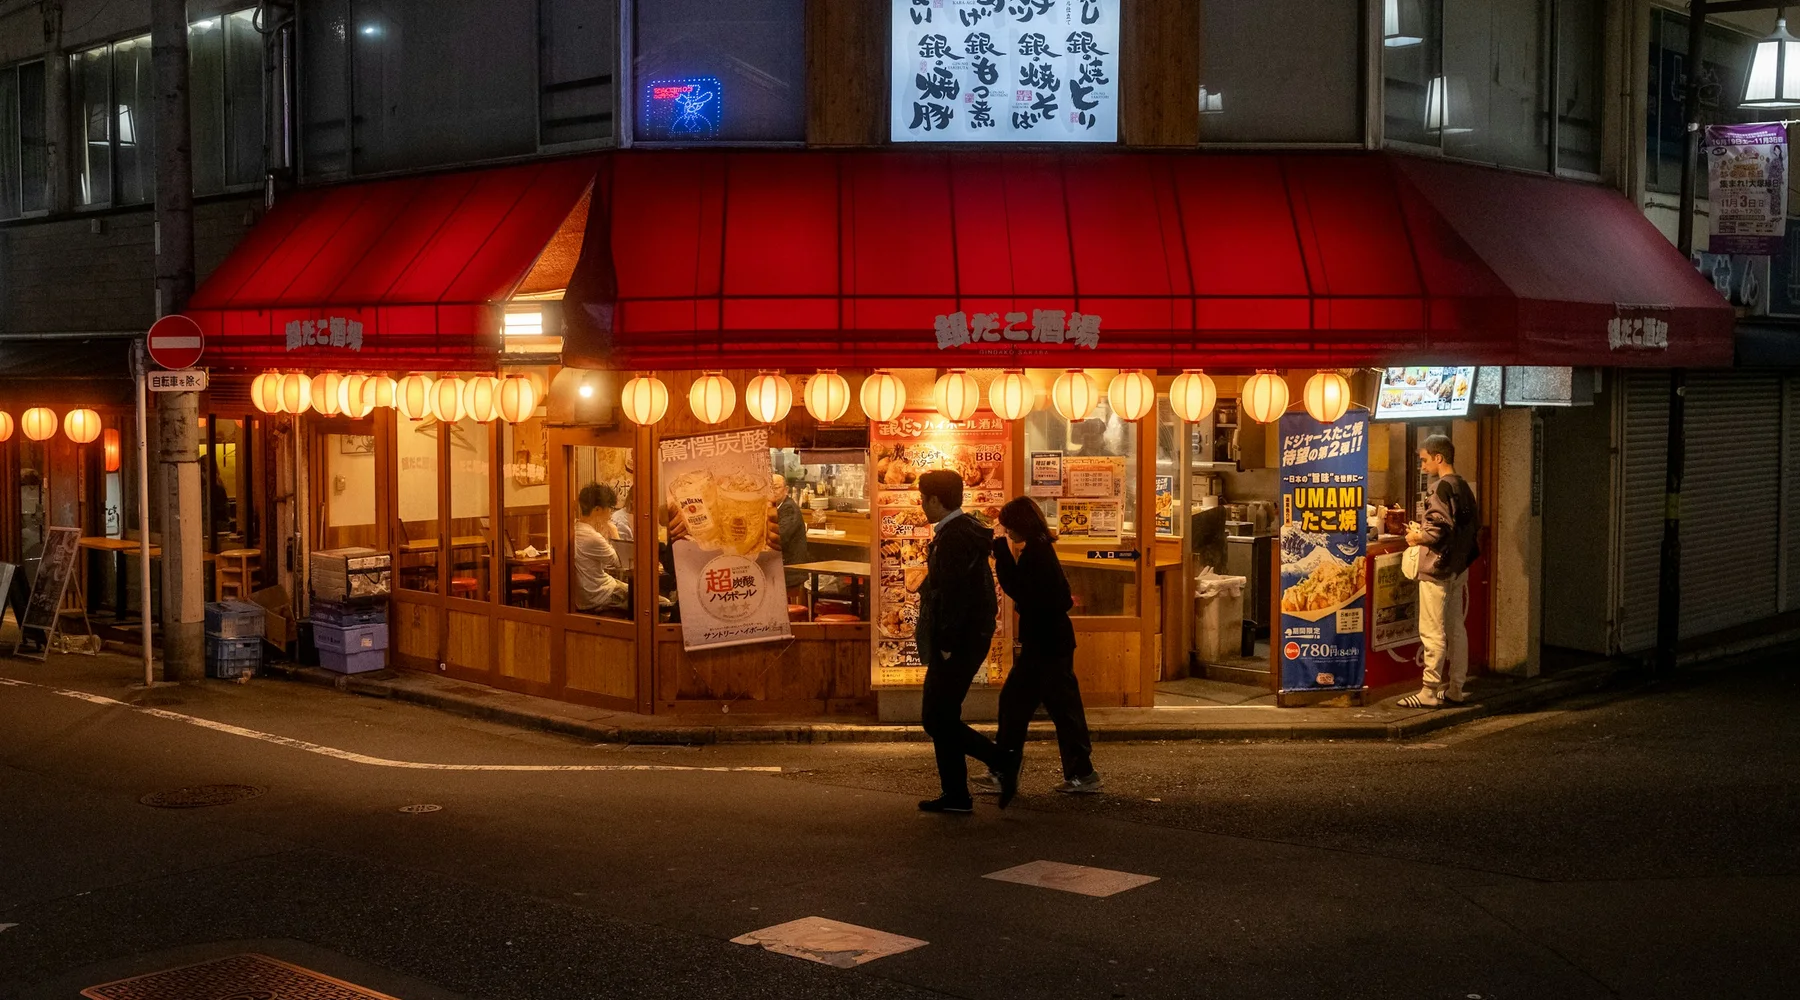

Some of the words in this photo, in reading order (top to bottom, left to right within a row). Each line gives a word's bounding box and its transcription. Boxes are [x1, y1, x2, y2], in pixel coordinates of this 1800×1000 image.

[285, 316, 363, 352] 銀だこ酒場
[934, 308, 1102, 350] 銀だこ酒場
[1607, 316, 1669, 351] 銀だこ酒場
[152, 375, 200, 388] 自転車を除く
[659, 428, 769, 462] 驚愕炭酸
[1283, 421, 1364, 450] ドジャースたこ焼
[975, 452, 1003, 462] BBQ
[1294, 486, 1363, 509] UMAMI
[1301, 508, 1357, 533] たこ焼
[1094, 551, 1115, 559] 入口
[709, 588, 758, 603] ハイボール
[703, 625, 770, 640] サントリーハイボール
[1292, 627, 1321, 635] 期間限定
